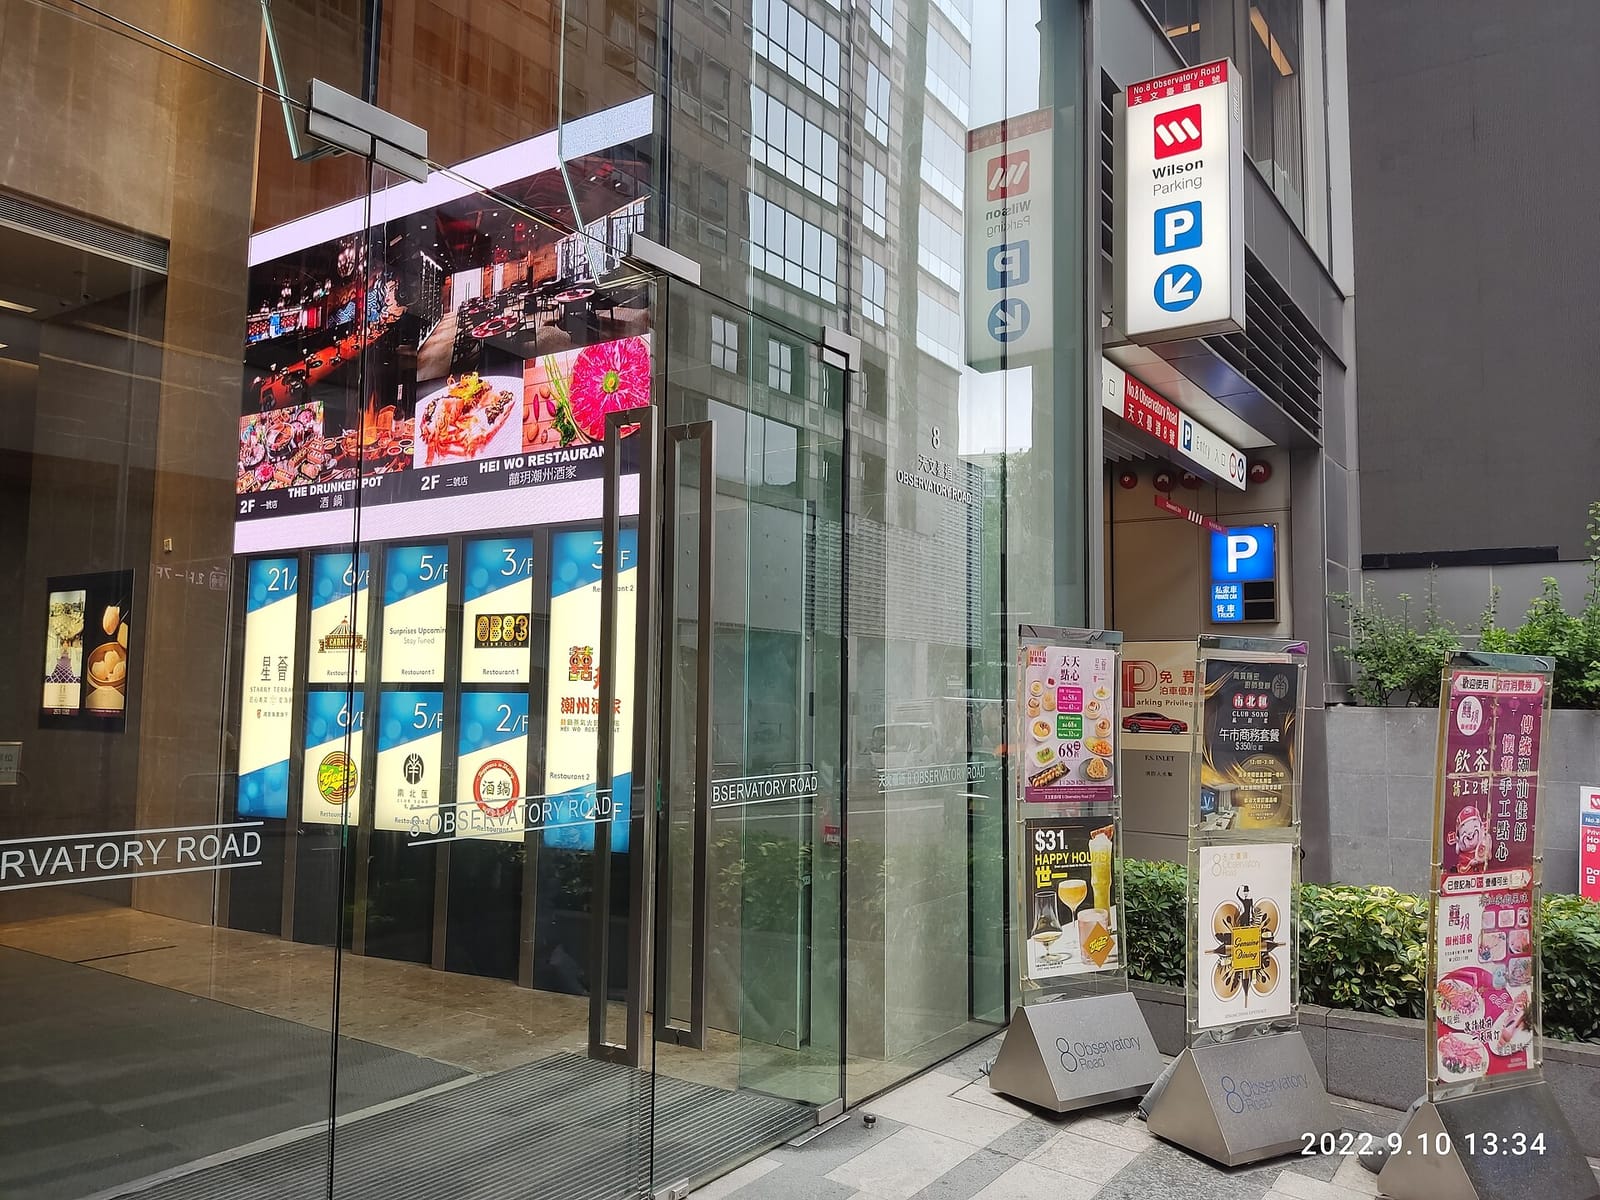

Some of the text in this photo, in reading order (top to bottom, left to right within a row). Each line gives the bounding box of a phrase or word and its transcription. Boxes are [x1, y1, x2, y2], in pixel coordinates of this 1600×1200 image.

[1133, 65, 1220, 94] No.8 Observatory Road
[1152, 158, 1204, 179] Wilson
[1153, 175, 1203, 196] Parking
[1164, 209, 1194, 248] P
[1127, 379, 1178, 426] No.8 Observatory Road
[931, 426, 940, 450] 8
[479, 460, 500, 474] HEI
[503, 457, 524, 470] WO
[288, 476, 384, 498] THE DRUNKEN POT
[420, 474, 441, 491] 2F
[896, 470, 972, 504] OBSERVATORY ROAD
[240, 499, 256, 514] 2F
[319, 494, 344, 509] 酒鍋
[1227, 534, 1258, 573] P
[390, 628, 416, 636] Surprises
[1060, 655, 1080, 668] 天天
[1060, 668, 1080, 681] 點心
[1218, 728, 1280, 743] 午市商務套餐
[1455, 748, 1489, 773] 飲茶
[550, 772, 582, 780] Restaurant
[790, 776, 818, 794] ROAD
[914, 767, 966, 785] OBSERVATORY
[967, 766, 986, 779] ROAD
[429, 801, 563, 836] OBSERVATORY
[568, 796, 613, 820] ROAD
[177, 831, 263, 863] ROAD
[1035, 852, 1069, 866] HAPPY
[1035, 866, 1068, 888] 世一
[1235, 948, 1258, 960] Dining
[1056, 1036, 1142, 1073] 8 Observatory
[1079, 1054, 1105, 1071] Road
[1221, 1073, 1308, 1114] 8 Observatory
